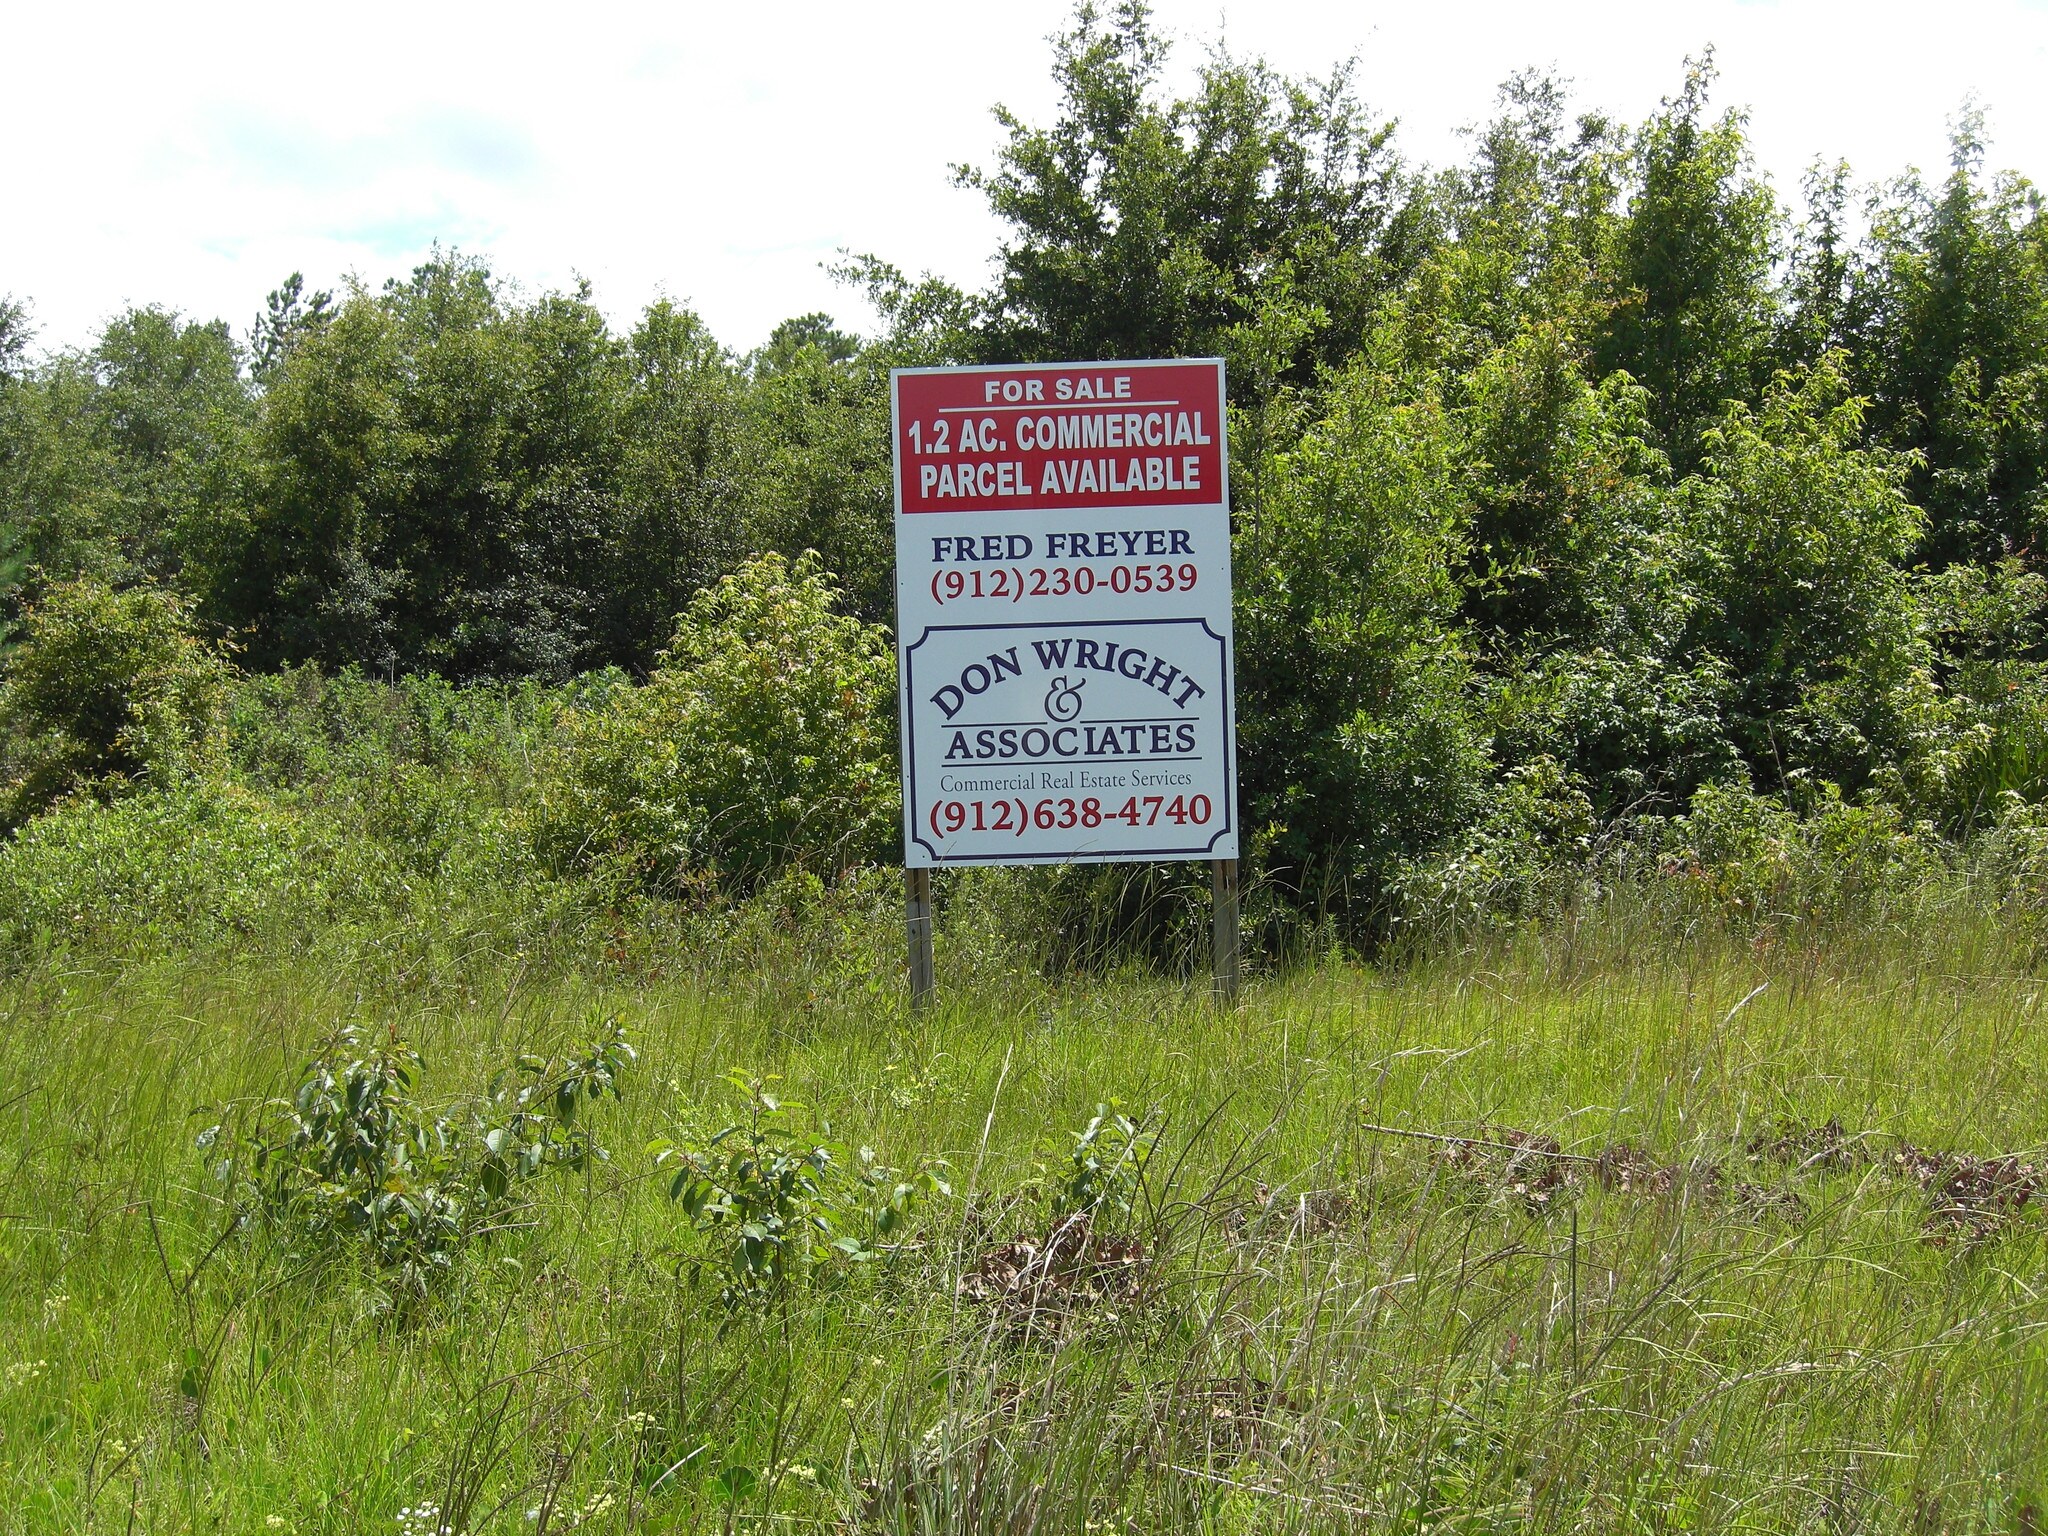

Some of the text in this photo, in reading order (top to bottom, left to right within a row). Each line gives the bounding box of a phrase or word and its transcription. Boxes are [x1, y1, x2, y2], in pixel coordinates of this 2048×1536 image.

[985, 376, 1131, 402] FOR SALE
[908, 411, 1211, 454] 1.2 AC. COMMERCIAL
[920, 456, 1201, 498] PARCEL AVAILABLE
[931, 529, 1195, 562] FRED FREYER
[931, 563, 1198, 605] (912)230-0539
[930, 638, 1206, 721] DON WRIGHT
[1044, 675, 1086, 723] &
[944, 723, 1196, 760] ASSOCIATES
[940, 769, 1192, 793] Commercial Real Estate Services
[930, 793, 1212, 839] (912)638-4740
